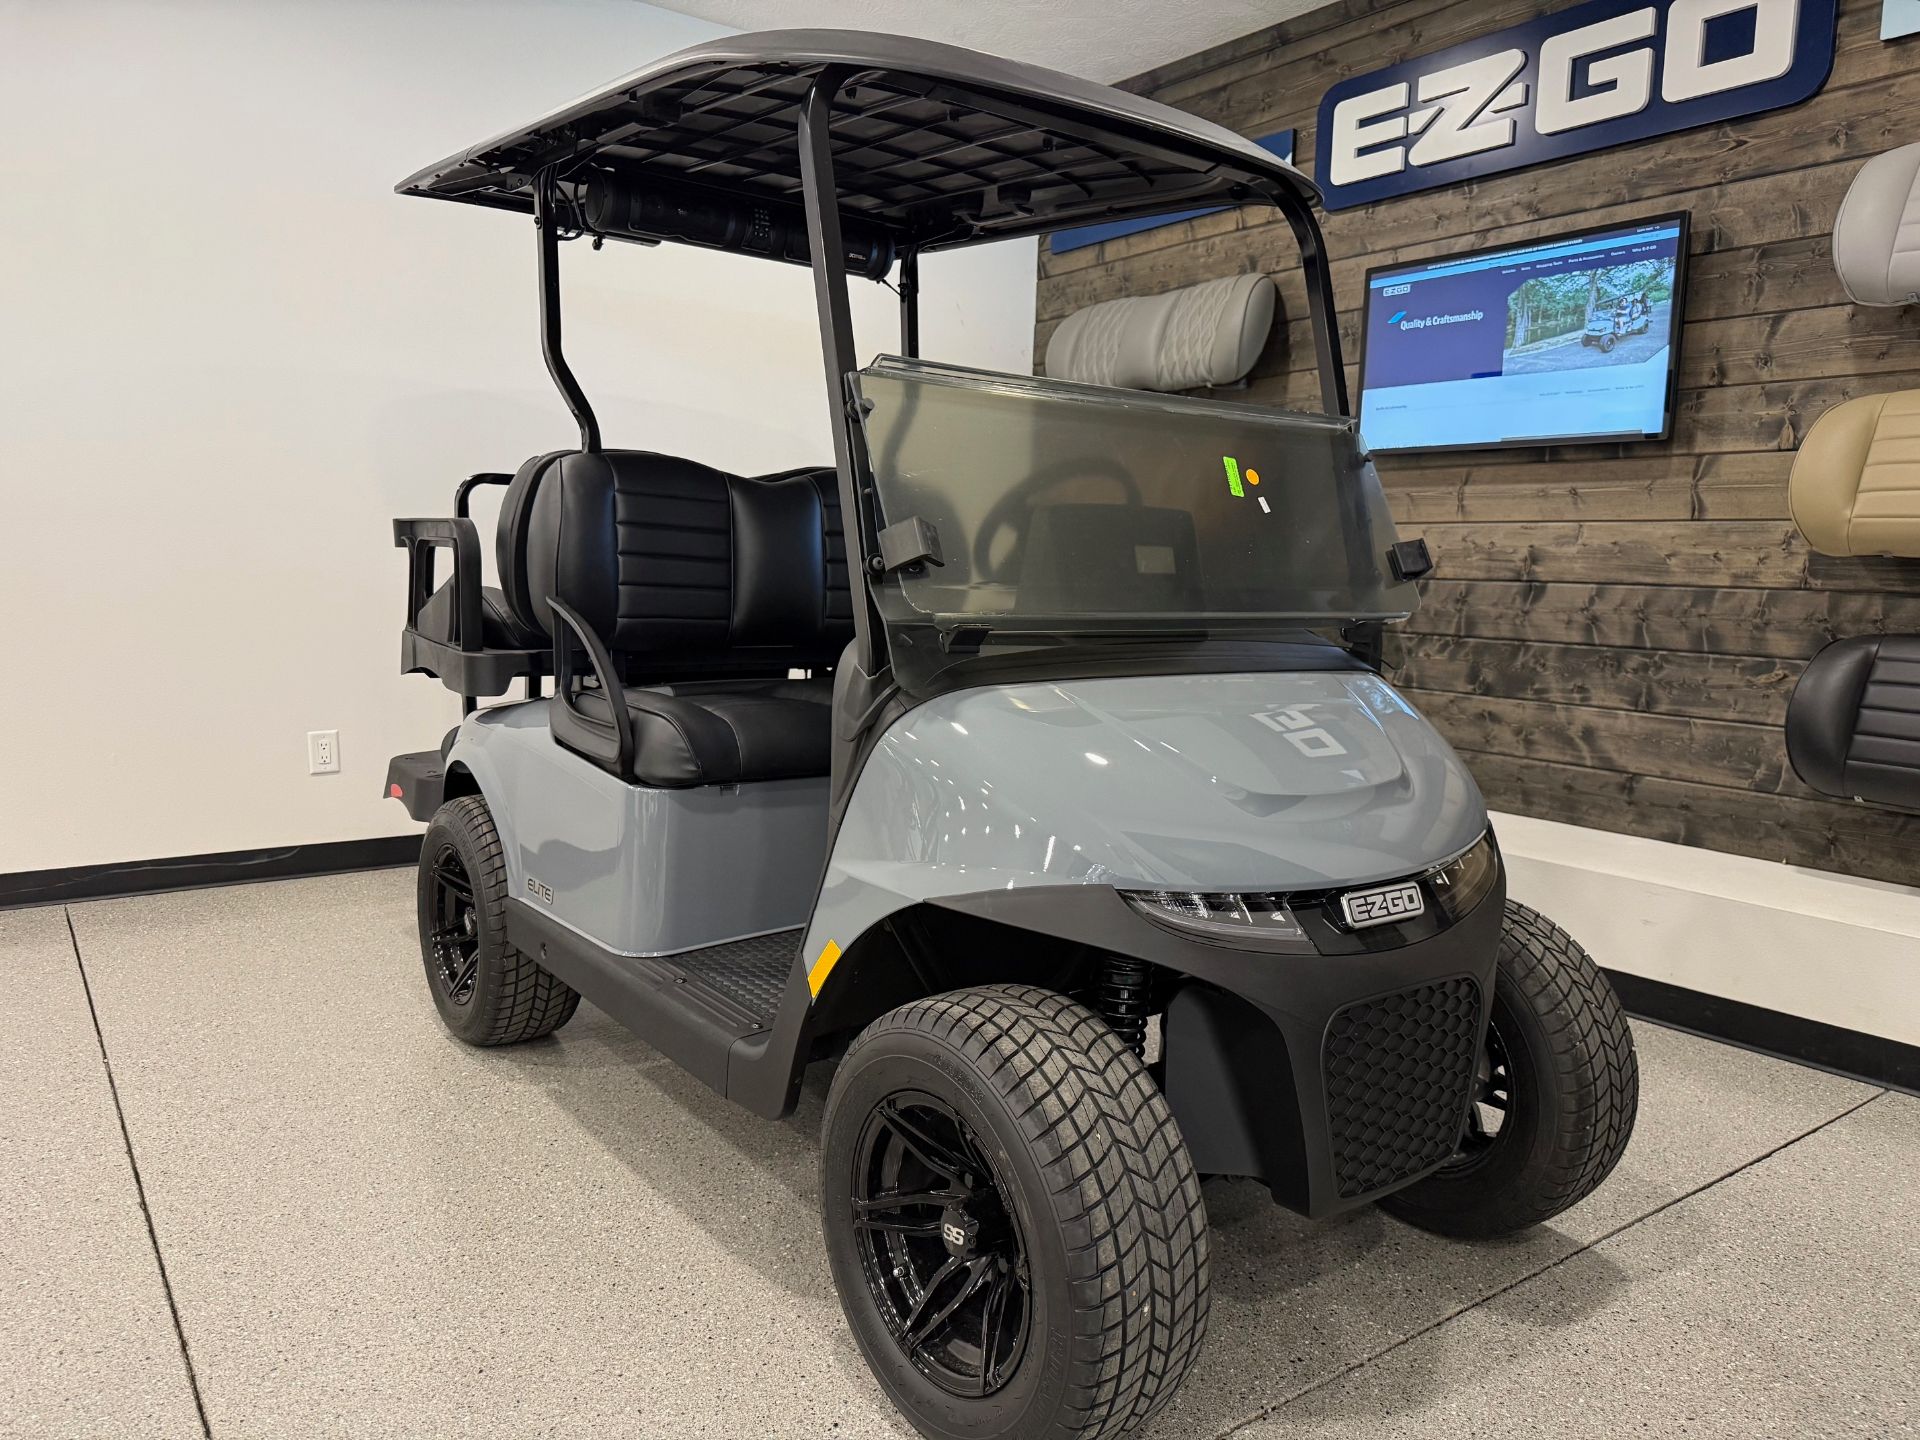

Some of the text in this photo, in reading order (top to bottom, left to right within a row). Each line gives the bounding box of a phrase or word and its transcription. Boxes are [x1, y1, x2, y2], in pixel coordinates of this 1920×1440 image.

[1400, 310, 1483, 331] Quality & Craftsmanship
[1350, 888, 1420, 921] EZGO
[943, 1223, 966, 1246] SS
